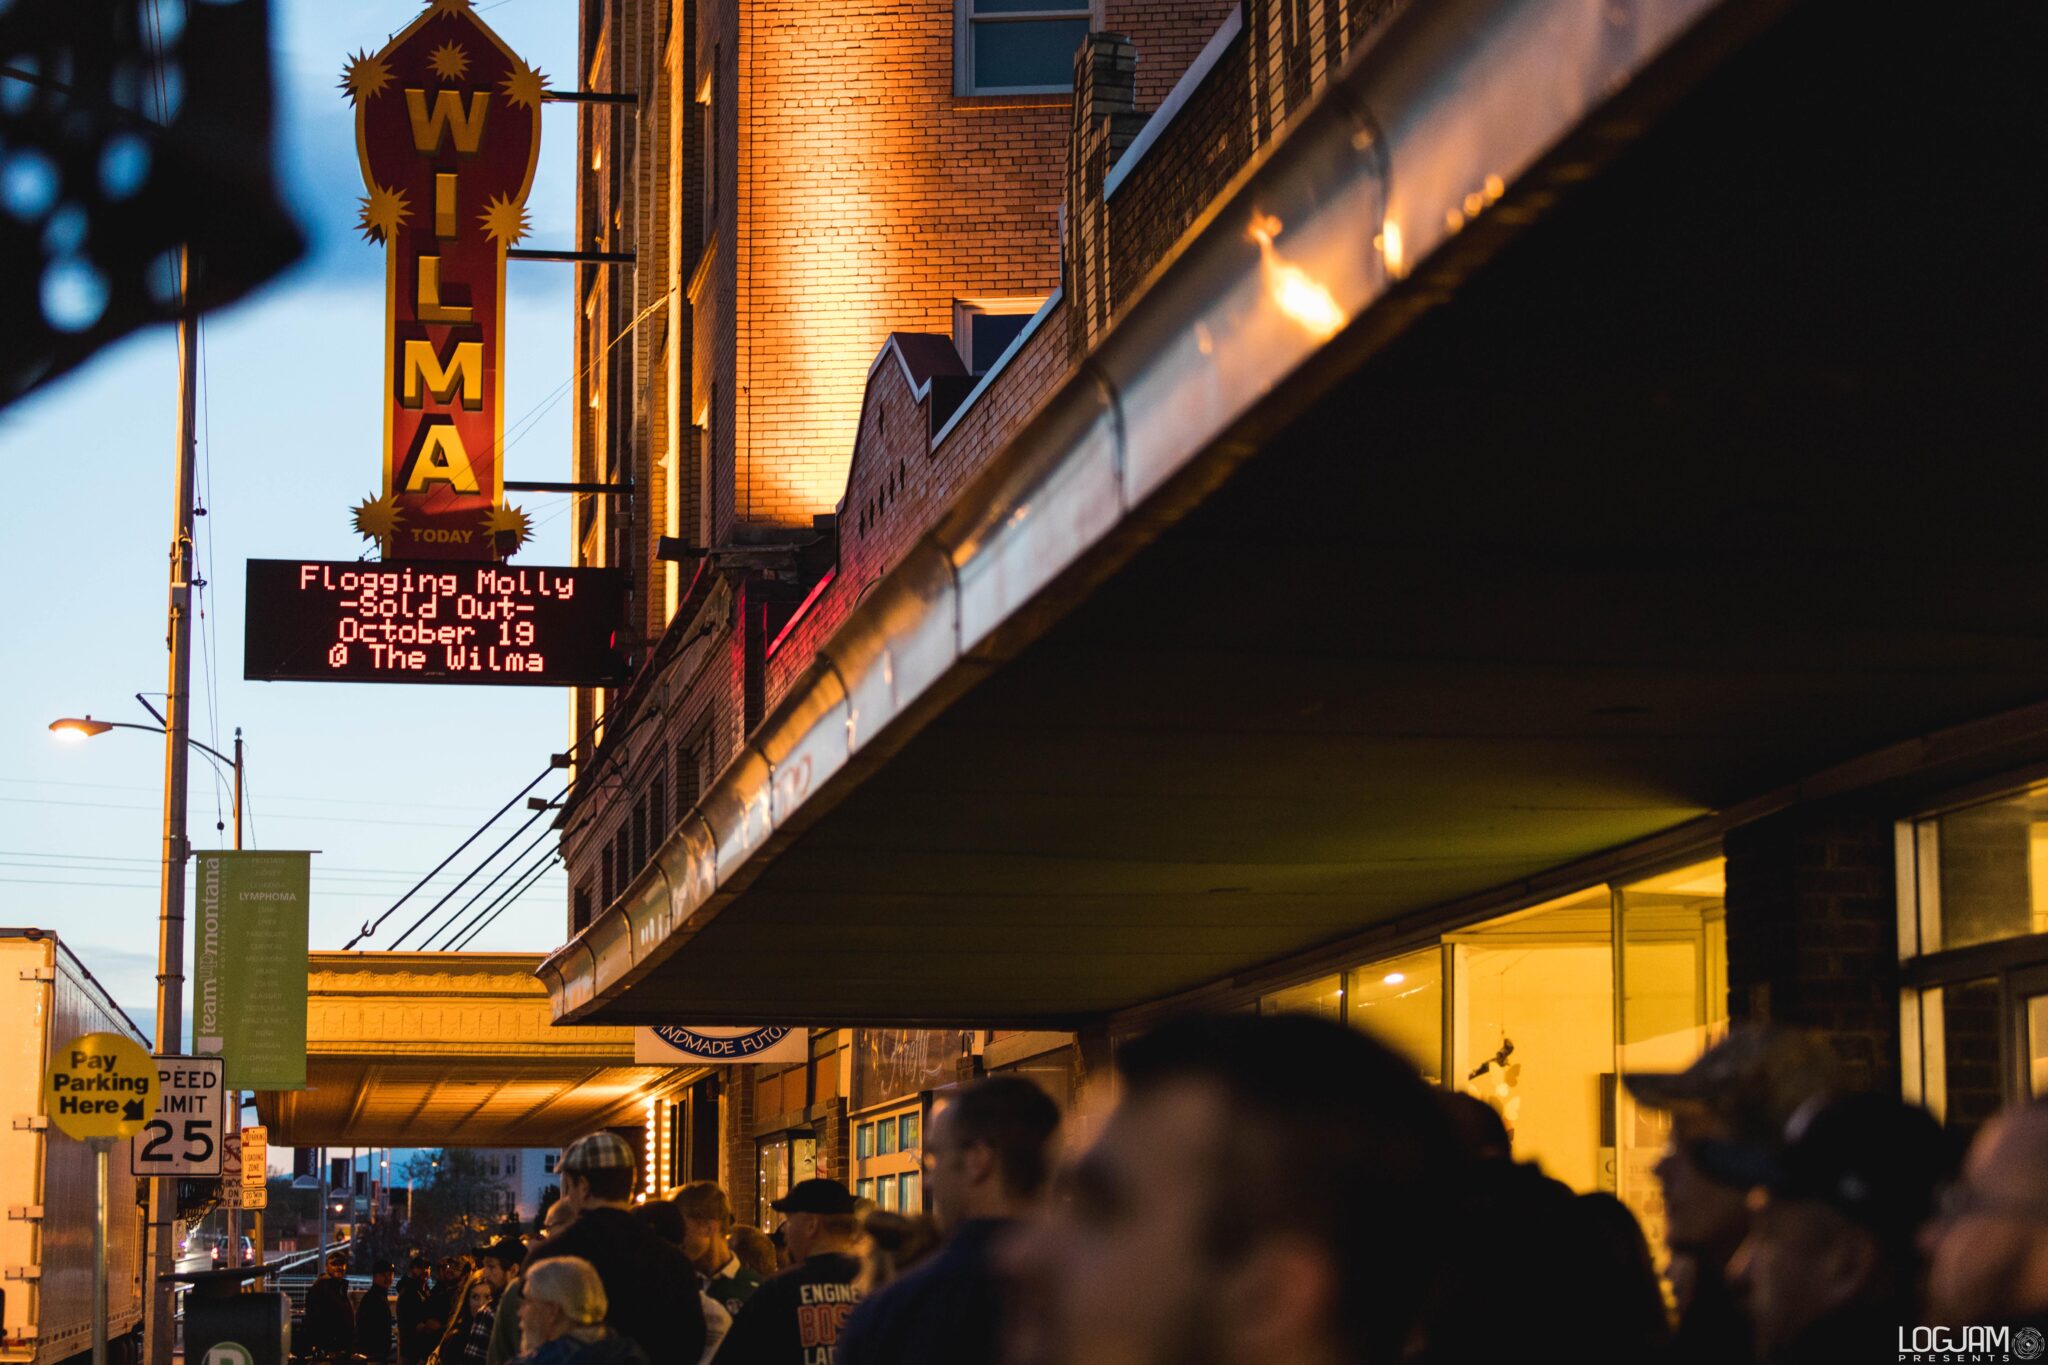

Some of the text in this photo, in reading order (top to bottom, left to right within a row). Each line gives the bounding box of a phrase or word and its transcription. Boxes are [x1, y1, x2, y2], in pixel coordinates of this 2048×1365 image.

[404, 89, 492, 494] WILMA
[411, 528, 473, 544] TODAY
[301, 565, 575, 600] Flogging Molly
[339, 617, 535, 646] October 19
[328, 643, 544, 672] @ The Wilma
[239, 892, 297, 901] LYMPHOMA
[659, 1026, 788, 1055] NDMADE FUTO
[71, 1051, 117, 1072] Pay
[53, 1073, 149, 1095] Parking
[158, 1071, 217, 1089] PEED
[60, 1096, 119, 1114] Here
[155, 1095, 208, 1113] IMIT
[141, 1119, 213, 1162] 25
[244, 1153, 264, 1161] LOADING
[248, 1163, 260, 1171] ZONE
[225, 1179, 242, 1188] BICYC
[228, 1190, 239, 1198] ON
